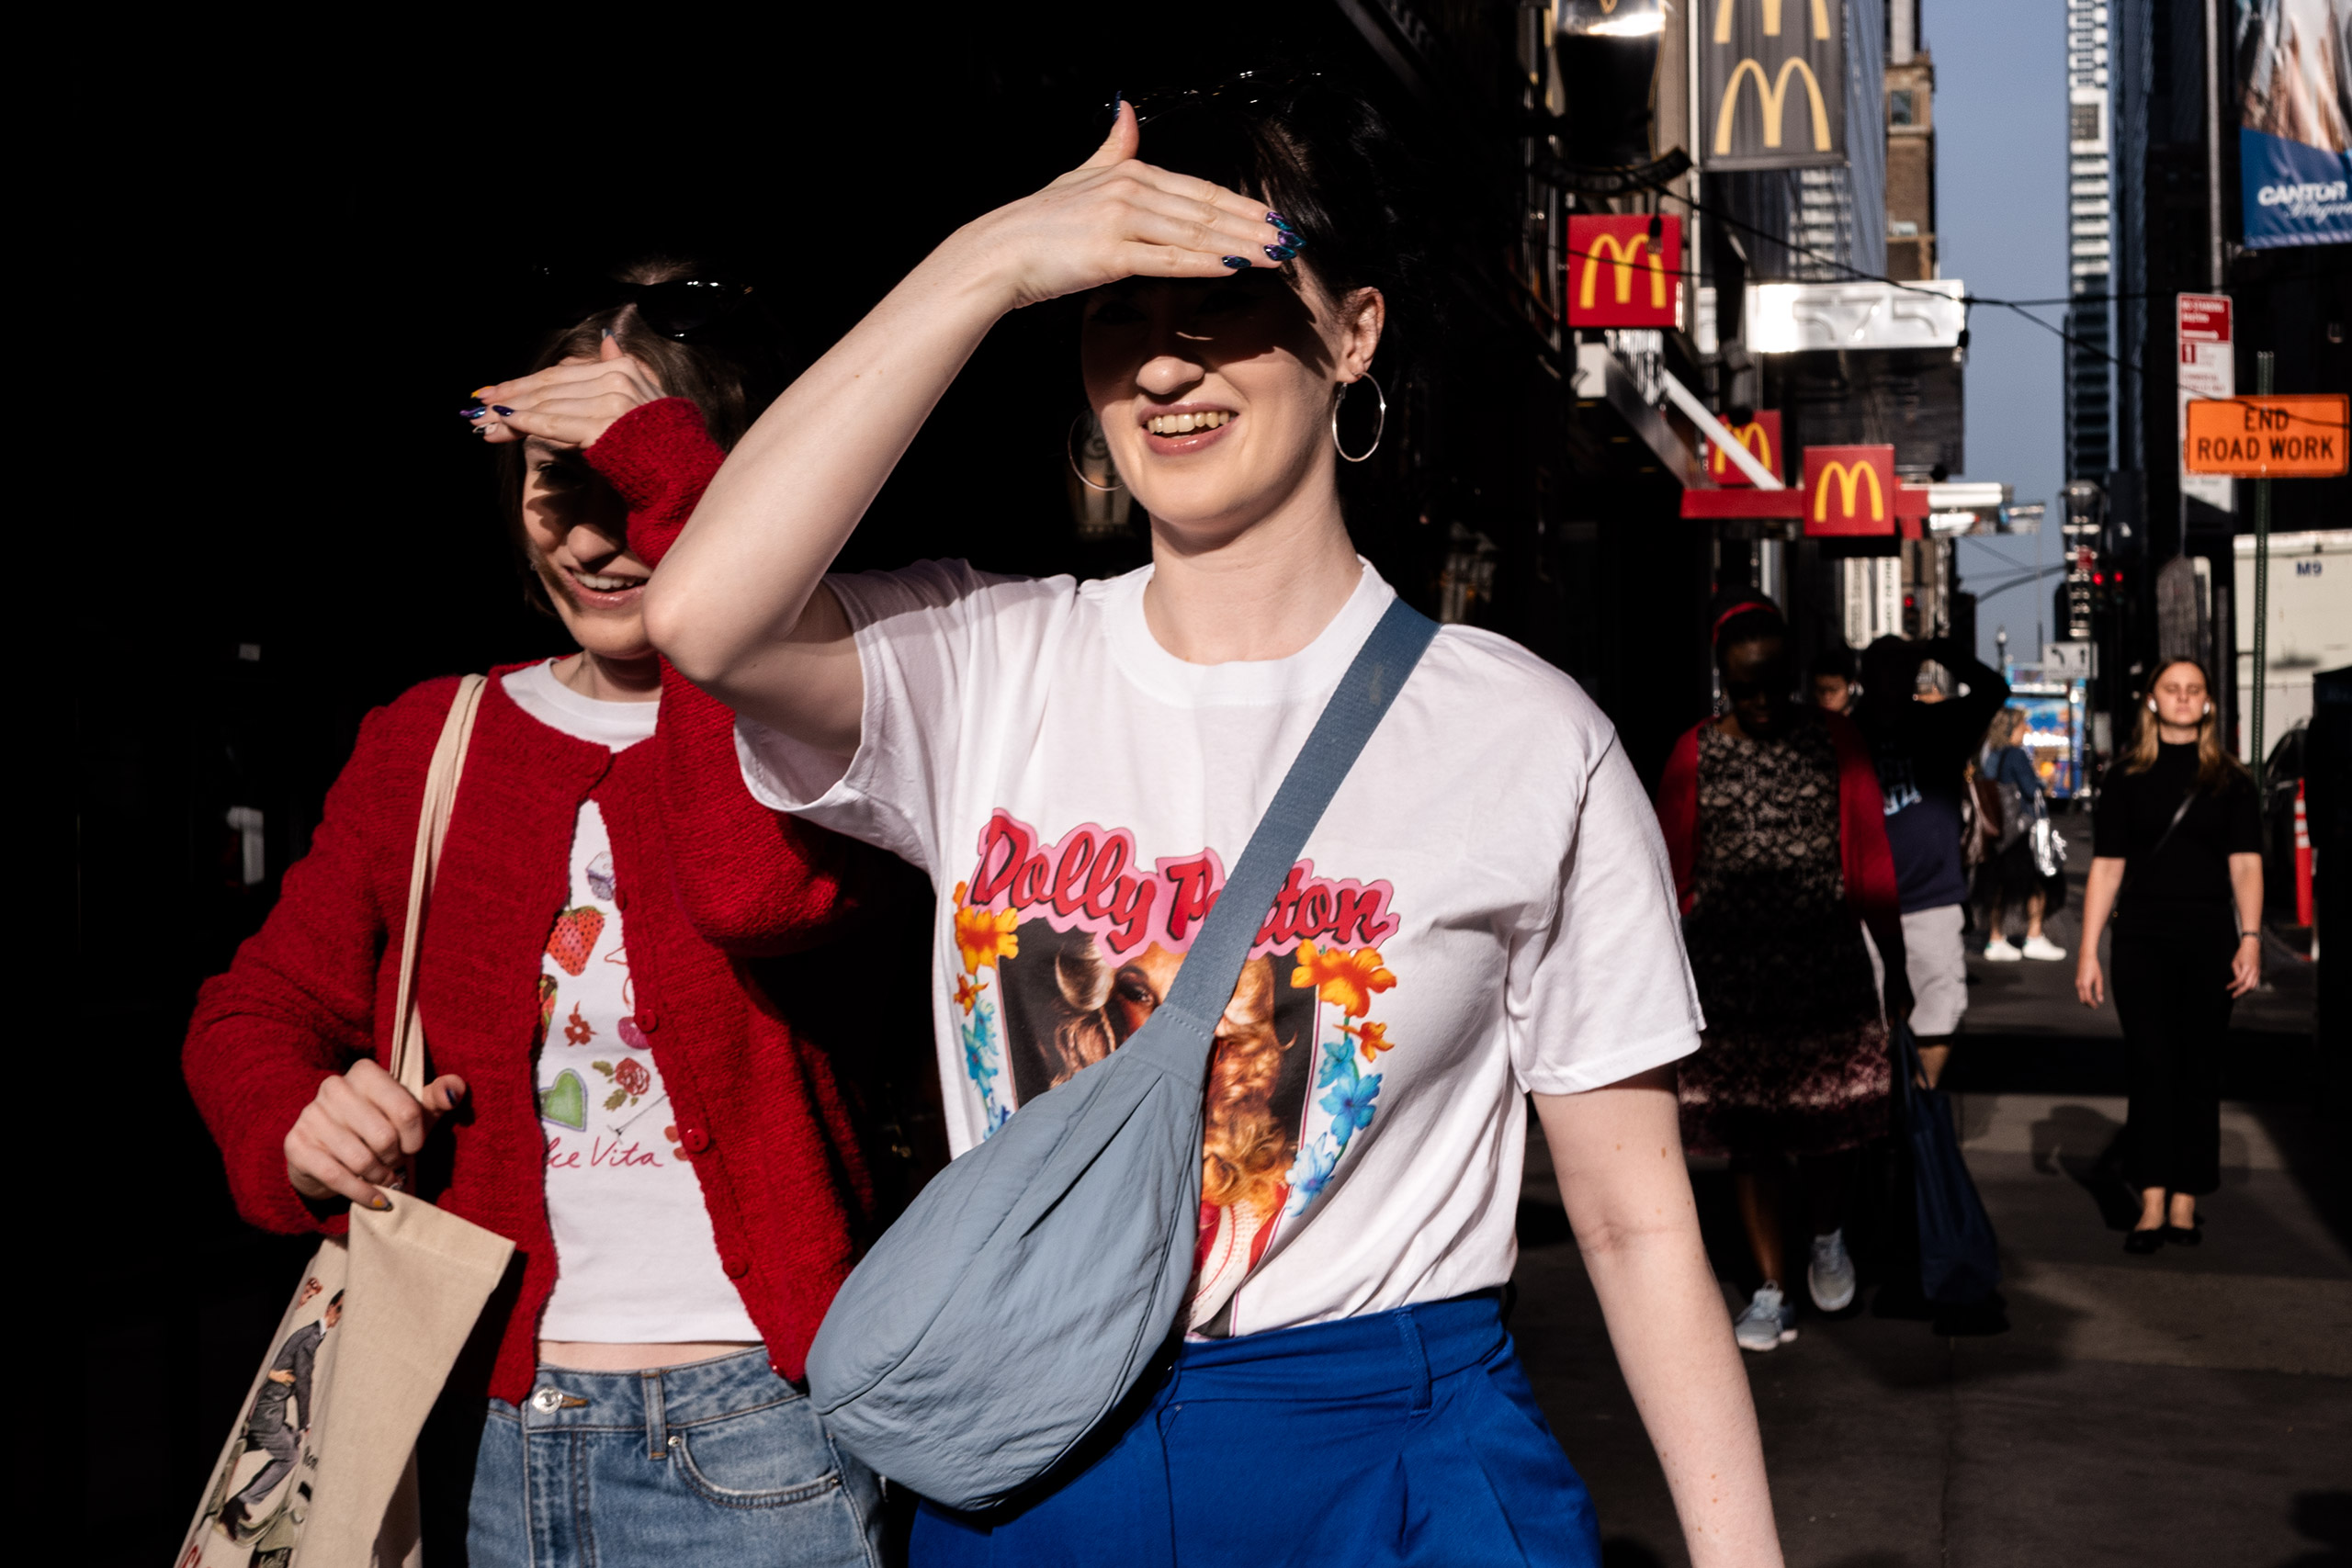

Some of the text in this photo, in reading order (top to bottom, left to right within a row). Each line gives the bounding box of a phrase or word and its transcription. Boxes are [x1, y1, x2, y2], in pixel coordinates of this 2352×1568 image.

[1713, 56, 1832, 155] M
[1579, 232, 1667, 310] M
[2198, 435, 2335, 461] ROAD WORK
[2245, 407, 2290, 432] END
[1814, 460, 1884, 523] M
[970, 815, 1389, 953] Dolly Pton
[548, 1135, 663, 1168] lce Vita
